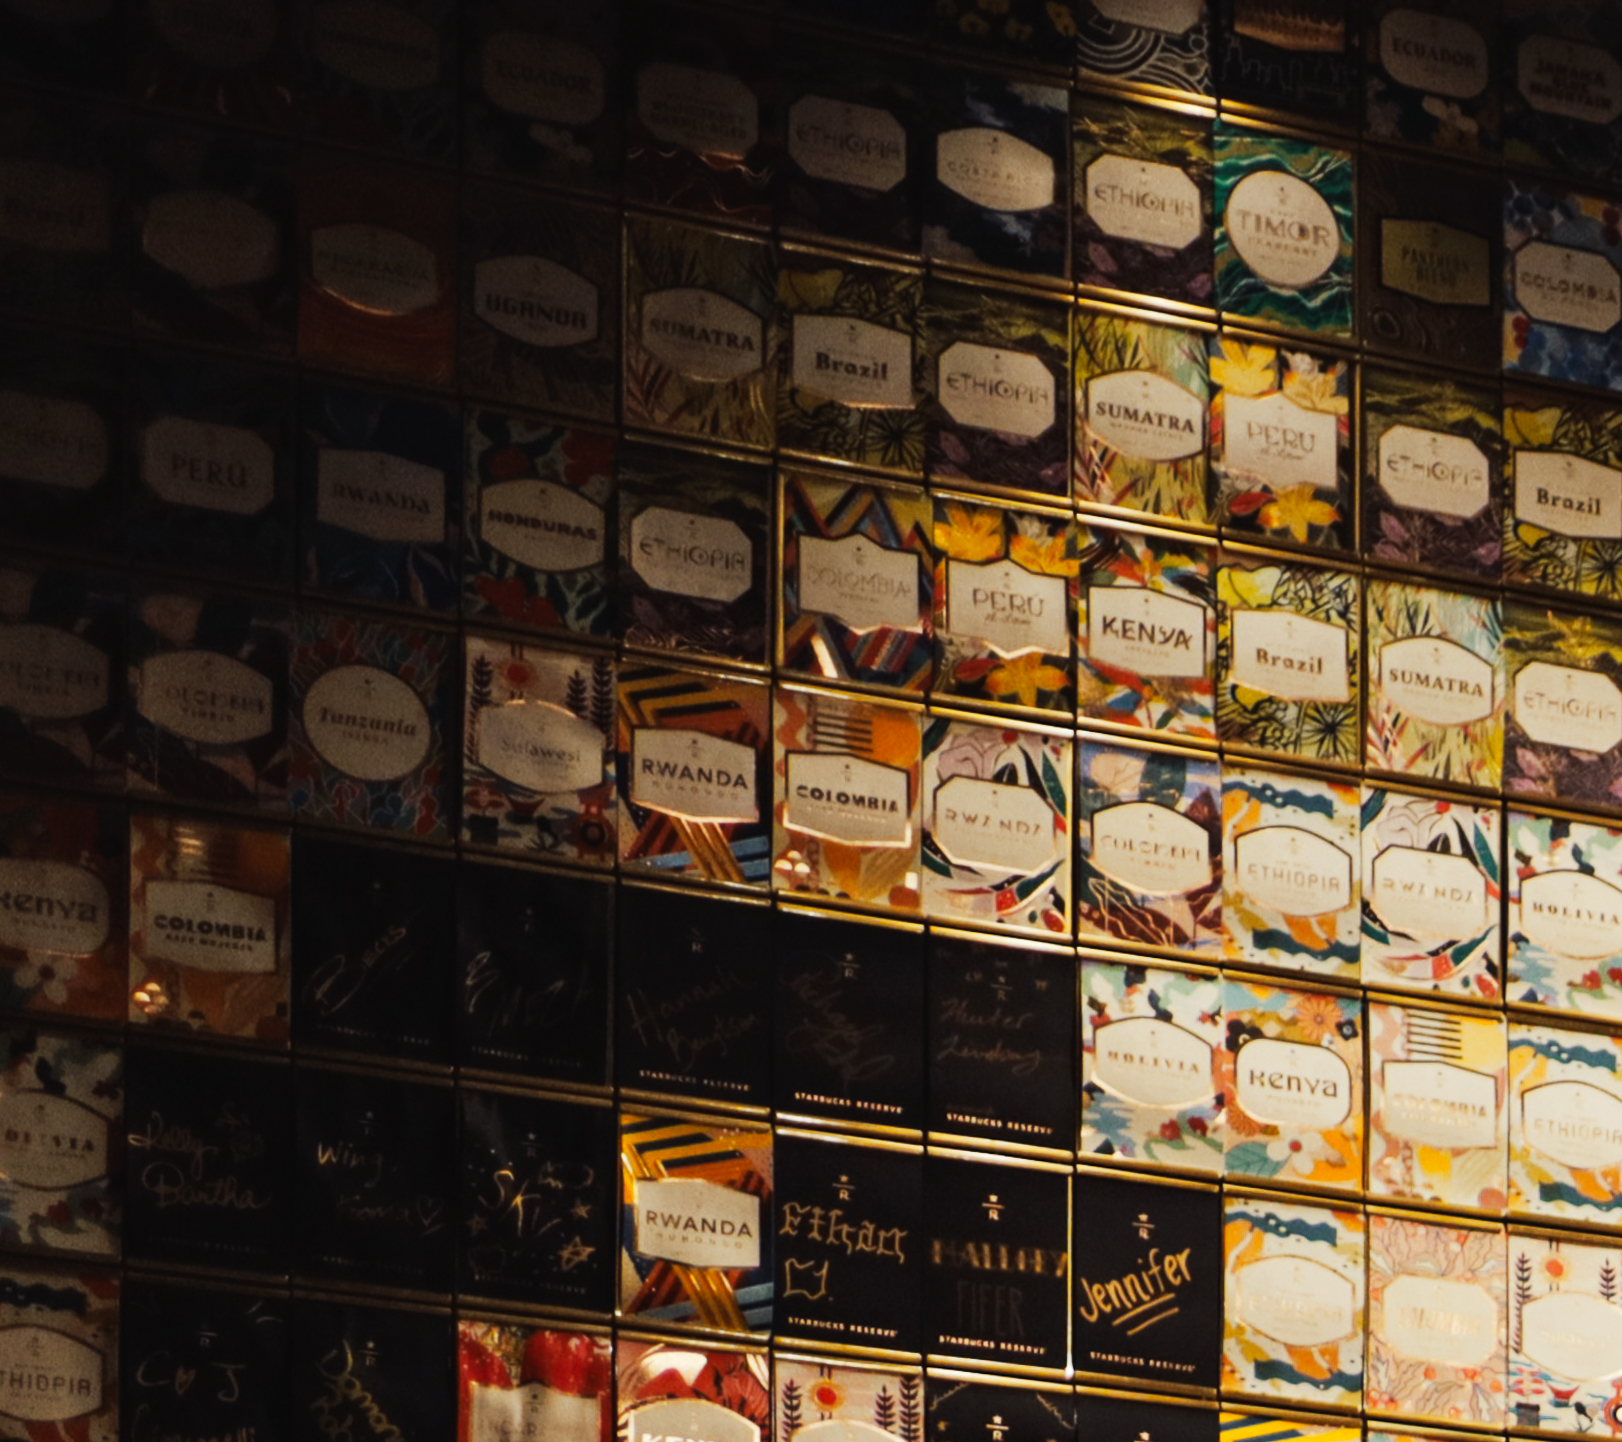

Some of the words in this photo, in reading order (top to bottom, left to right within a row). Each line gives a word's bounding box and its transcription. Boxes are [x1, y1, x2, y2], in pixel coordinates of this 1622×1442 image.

[1237, 208, 1330, 248] TIMOR
[814, 351, 887, 380] Brazil
[1096, 402, 1194, 434] SUMATRA
[1537, 487, 1601, 515] Brazil
[488, 509, 597, 540] HONDURAS
[1102, 616, 1191, 649] KENYA
[1390, 669, 1482, 697] SUMATRA
[642, 758, 747, 789] RWANDA
[796, 785, 897, 812] COLOMBIA
[155, 915, 266, 947] COLOMBIA
[1249, 1070, 1337, 1098] Kenya
[647, 1211, 752, 1241] RWANDA
[1080, 1248, 1190, 1324] Jennifer
[789, 1317, 844, 1330] STARBUCKS
[850, 1325, 897, 1337] RESERVE
[1090, 1351, 1144, 1365] STARBUCKS
[1148, 1359, 1195, 1372] RESERVE
